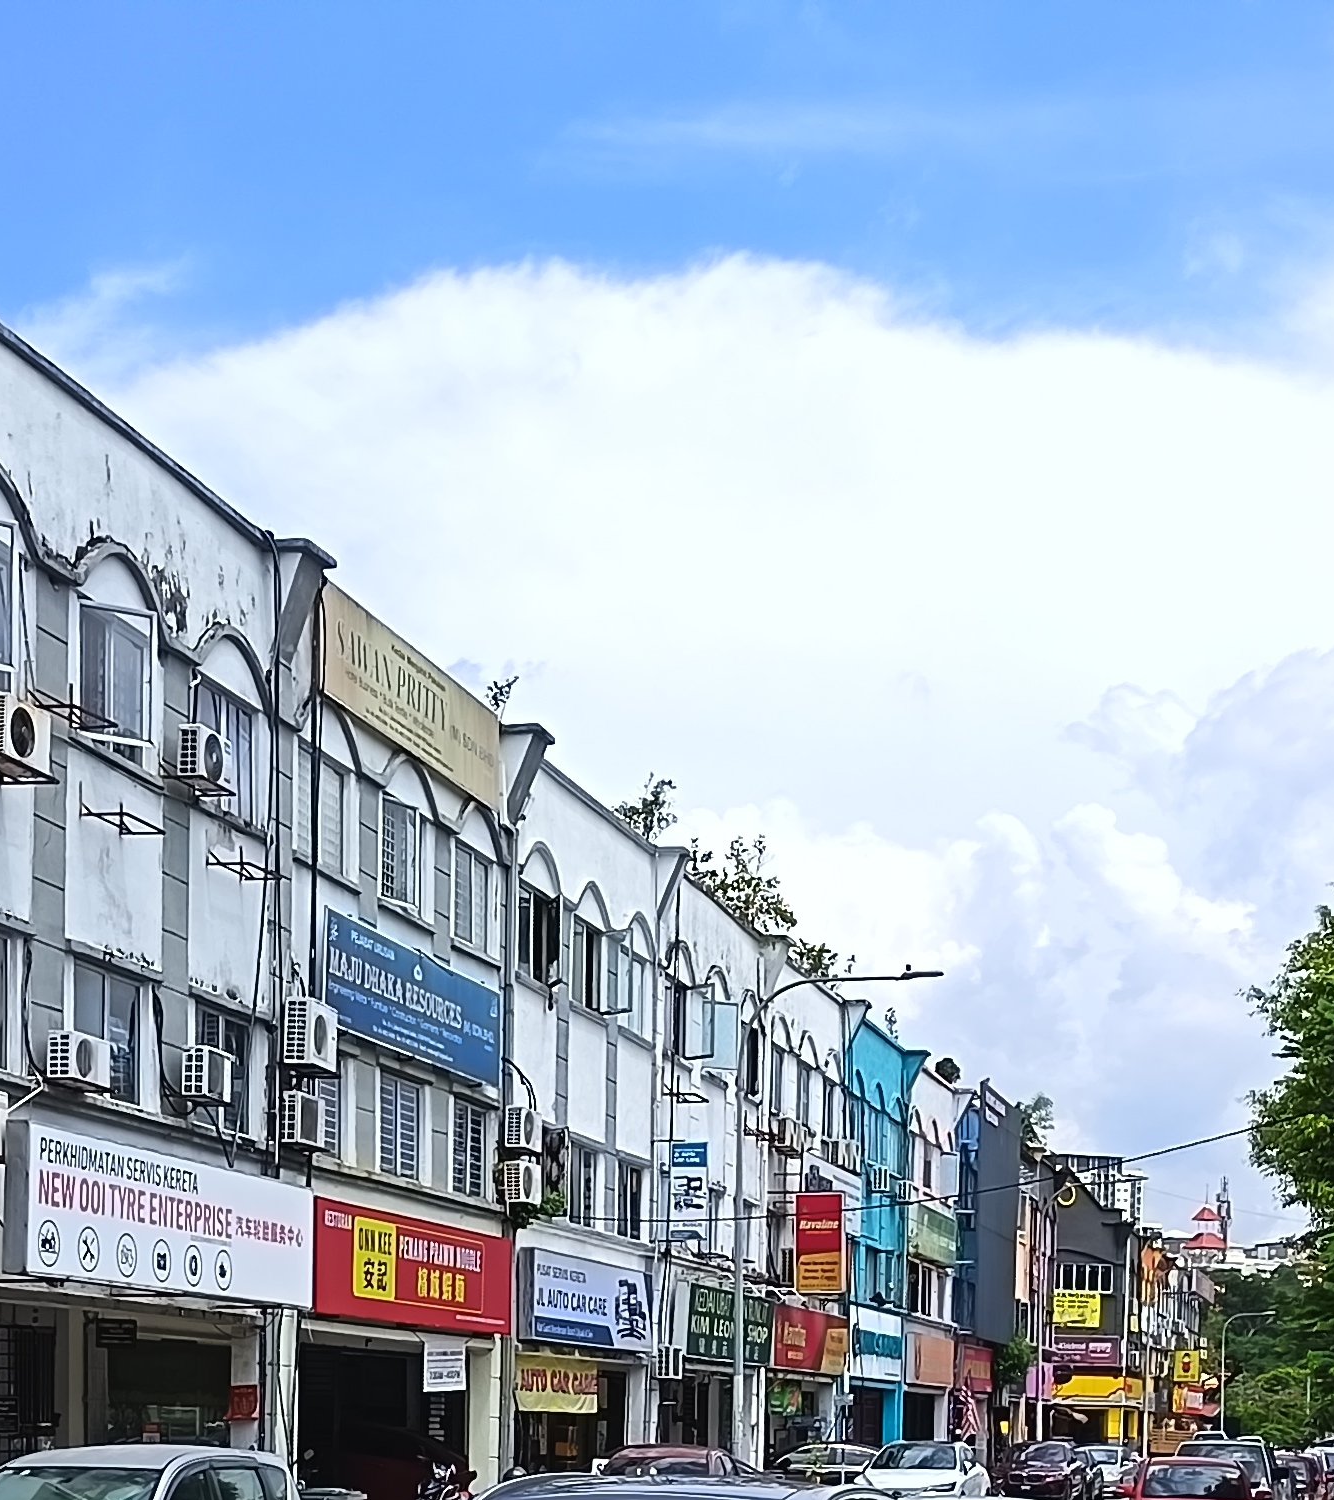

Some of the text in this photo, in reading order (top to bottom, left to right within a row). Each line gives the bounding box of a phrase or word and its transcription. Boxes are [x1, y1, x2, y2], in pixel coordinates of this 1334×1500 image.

[336, 619, 394, 692] SAWAN
[396, 665, 448, 732] PRITTY
[328, 946, 363, 985] MAJU
[364, 962, 404, 1005] DHAKA
[405, 982, 462, 1029] RESOURCES
[39, 1136, 199, 1195] PERKHIDMATAN SERVIS KERETA
[38, 1169, 234, 1240] NEW OOI TYRE ENTERPRISE
[798, 1219, 840, 1230] Havoline
[358, 1227, 393, 1256] ONN KEE
[362, 1257, 388, 1292] 安記
[547, 1288, 569, 1311] AUTO
[570, 1292, 587, 1314] CAR
[588, 1296, 608, 1317] CARE
[690, 1314, 769, 1344] KIM LEON SHOP
[519, 1368, 598, 1396] AUTO CAR CARE
